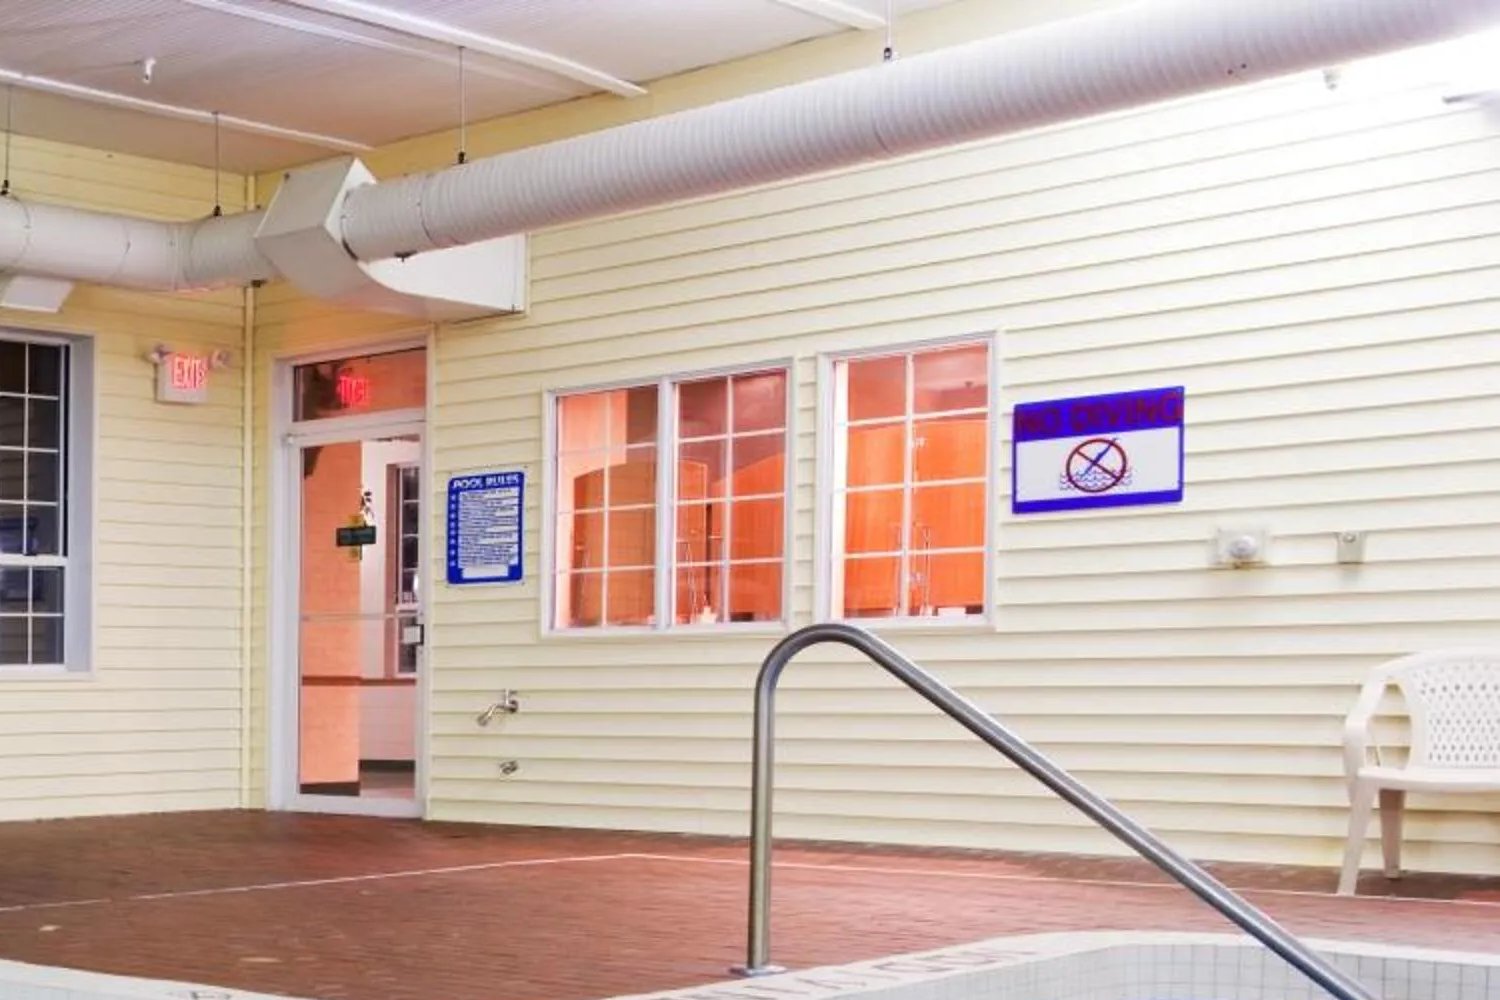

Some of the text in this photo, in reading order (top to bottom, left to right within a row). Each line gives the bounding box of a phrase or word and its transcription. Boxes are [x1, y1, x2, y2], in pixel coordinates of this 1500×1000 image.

[172, 356, 206, 388] EXIT
[1016, 391, 1183, 438] NO DIVING
